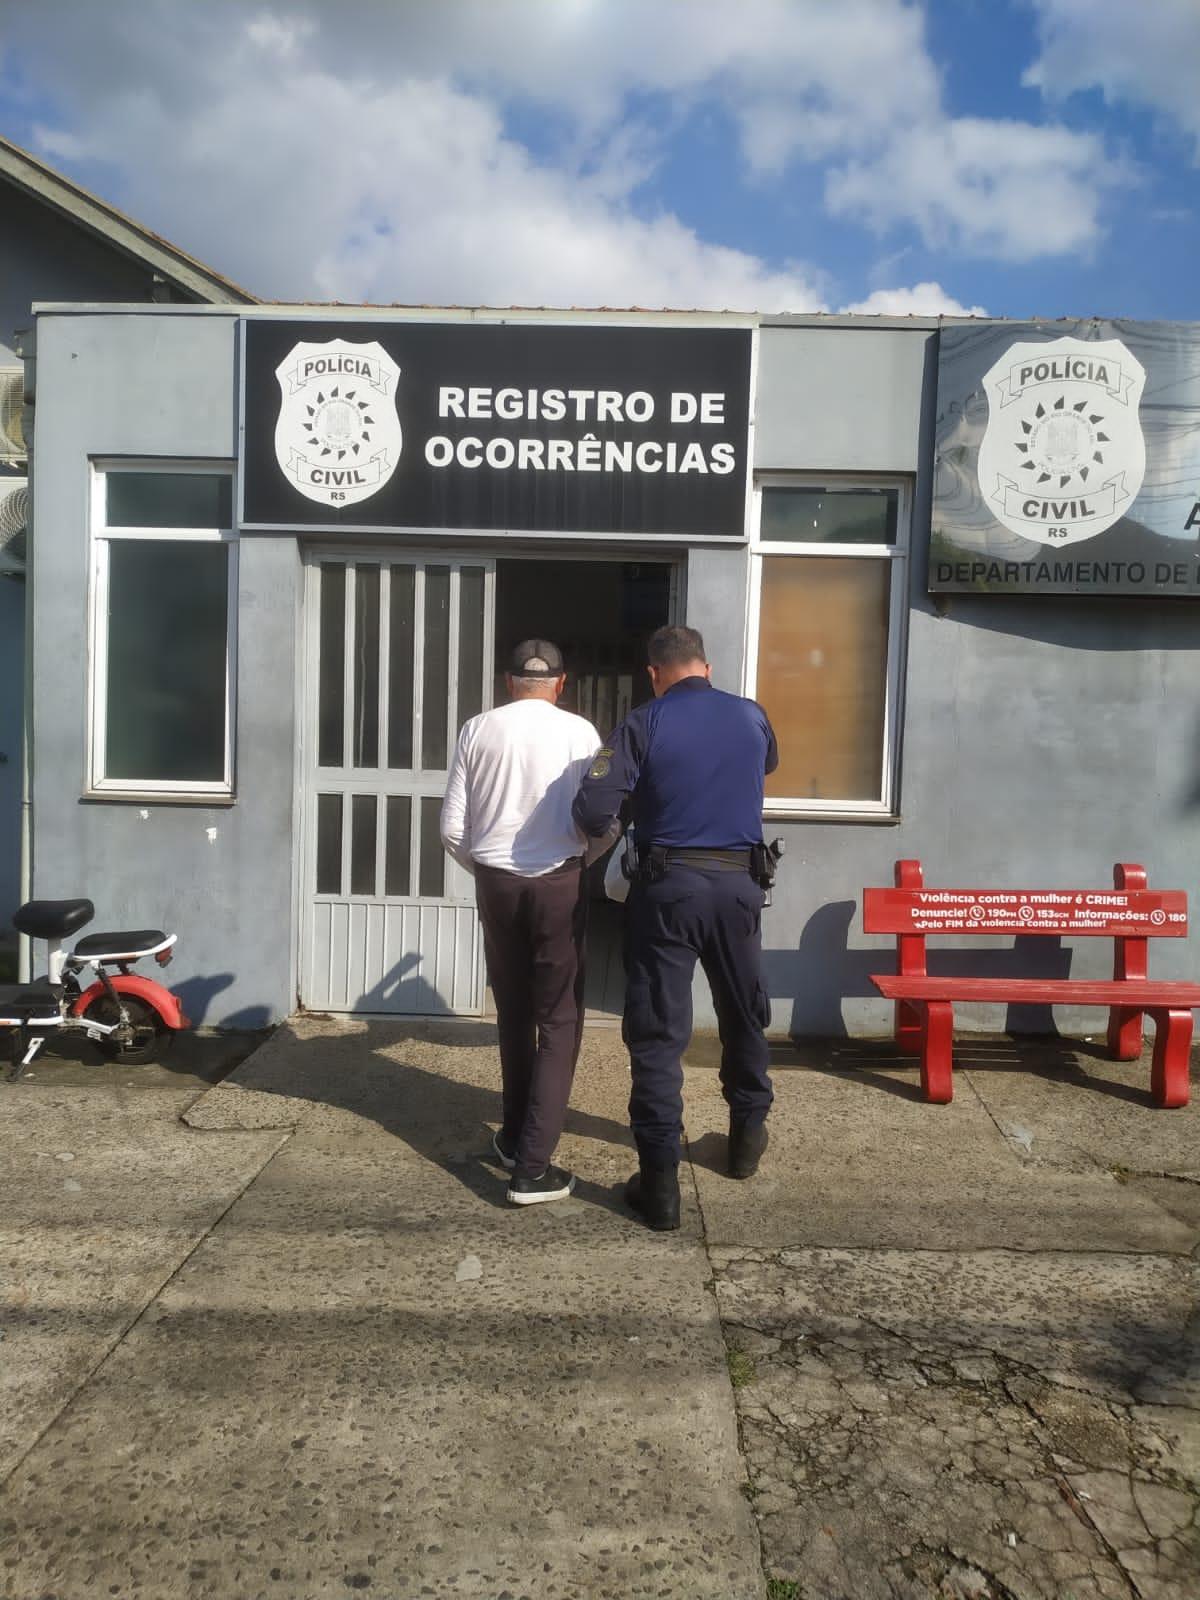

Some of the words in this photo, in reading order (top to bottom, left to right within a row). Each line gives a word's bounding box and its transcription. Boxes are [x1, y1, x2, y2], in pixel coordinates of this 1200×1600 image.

[305, 355, 372, 377] POLÍCIA
[1020, 357, 1109, 385] POLÍCIA
[438, 387, 655, 423] REGISTRO
[670, 393, 726, 424] DE
[425, 434, 735, 475] OCORRÊNCIAS
[310, 469, 366, 485] CIVIL
[331, 492, 346, 500] RS
[1022, 499, 1095, 519] CIVIL
[1048, 527, 1068, 538] RS
[937, 562, 1145, 584] DEPARTAMENTO
[1155, 563, 1188, 584] DE
[920, 893, 975, 903] Violência
[978, 894, 1017, 903] contra
[1030, 894, 1072, 904] mulher
[1075, 894, 1083, 904] é
[1086, 895, 1128, 906] CRIME!
[911, 908, 968, 917] Denuncie!
[1075, 909, 1149, 921] Informações:
[921, 920, 943, 928] Pelo
[945, 920, 964, 928] FIM
[966, 919, 979, 927] da
